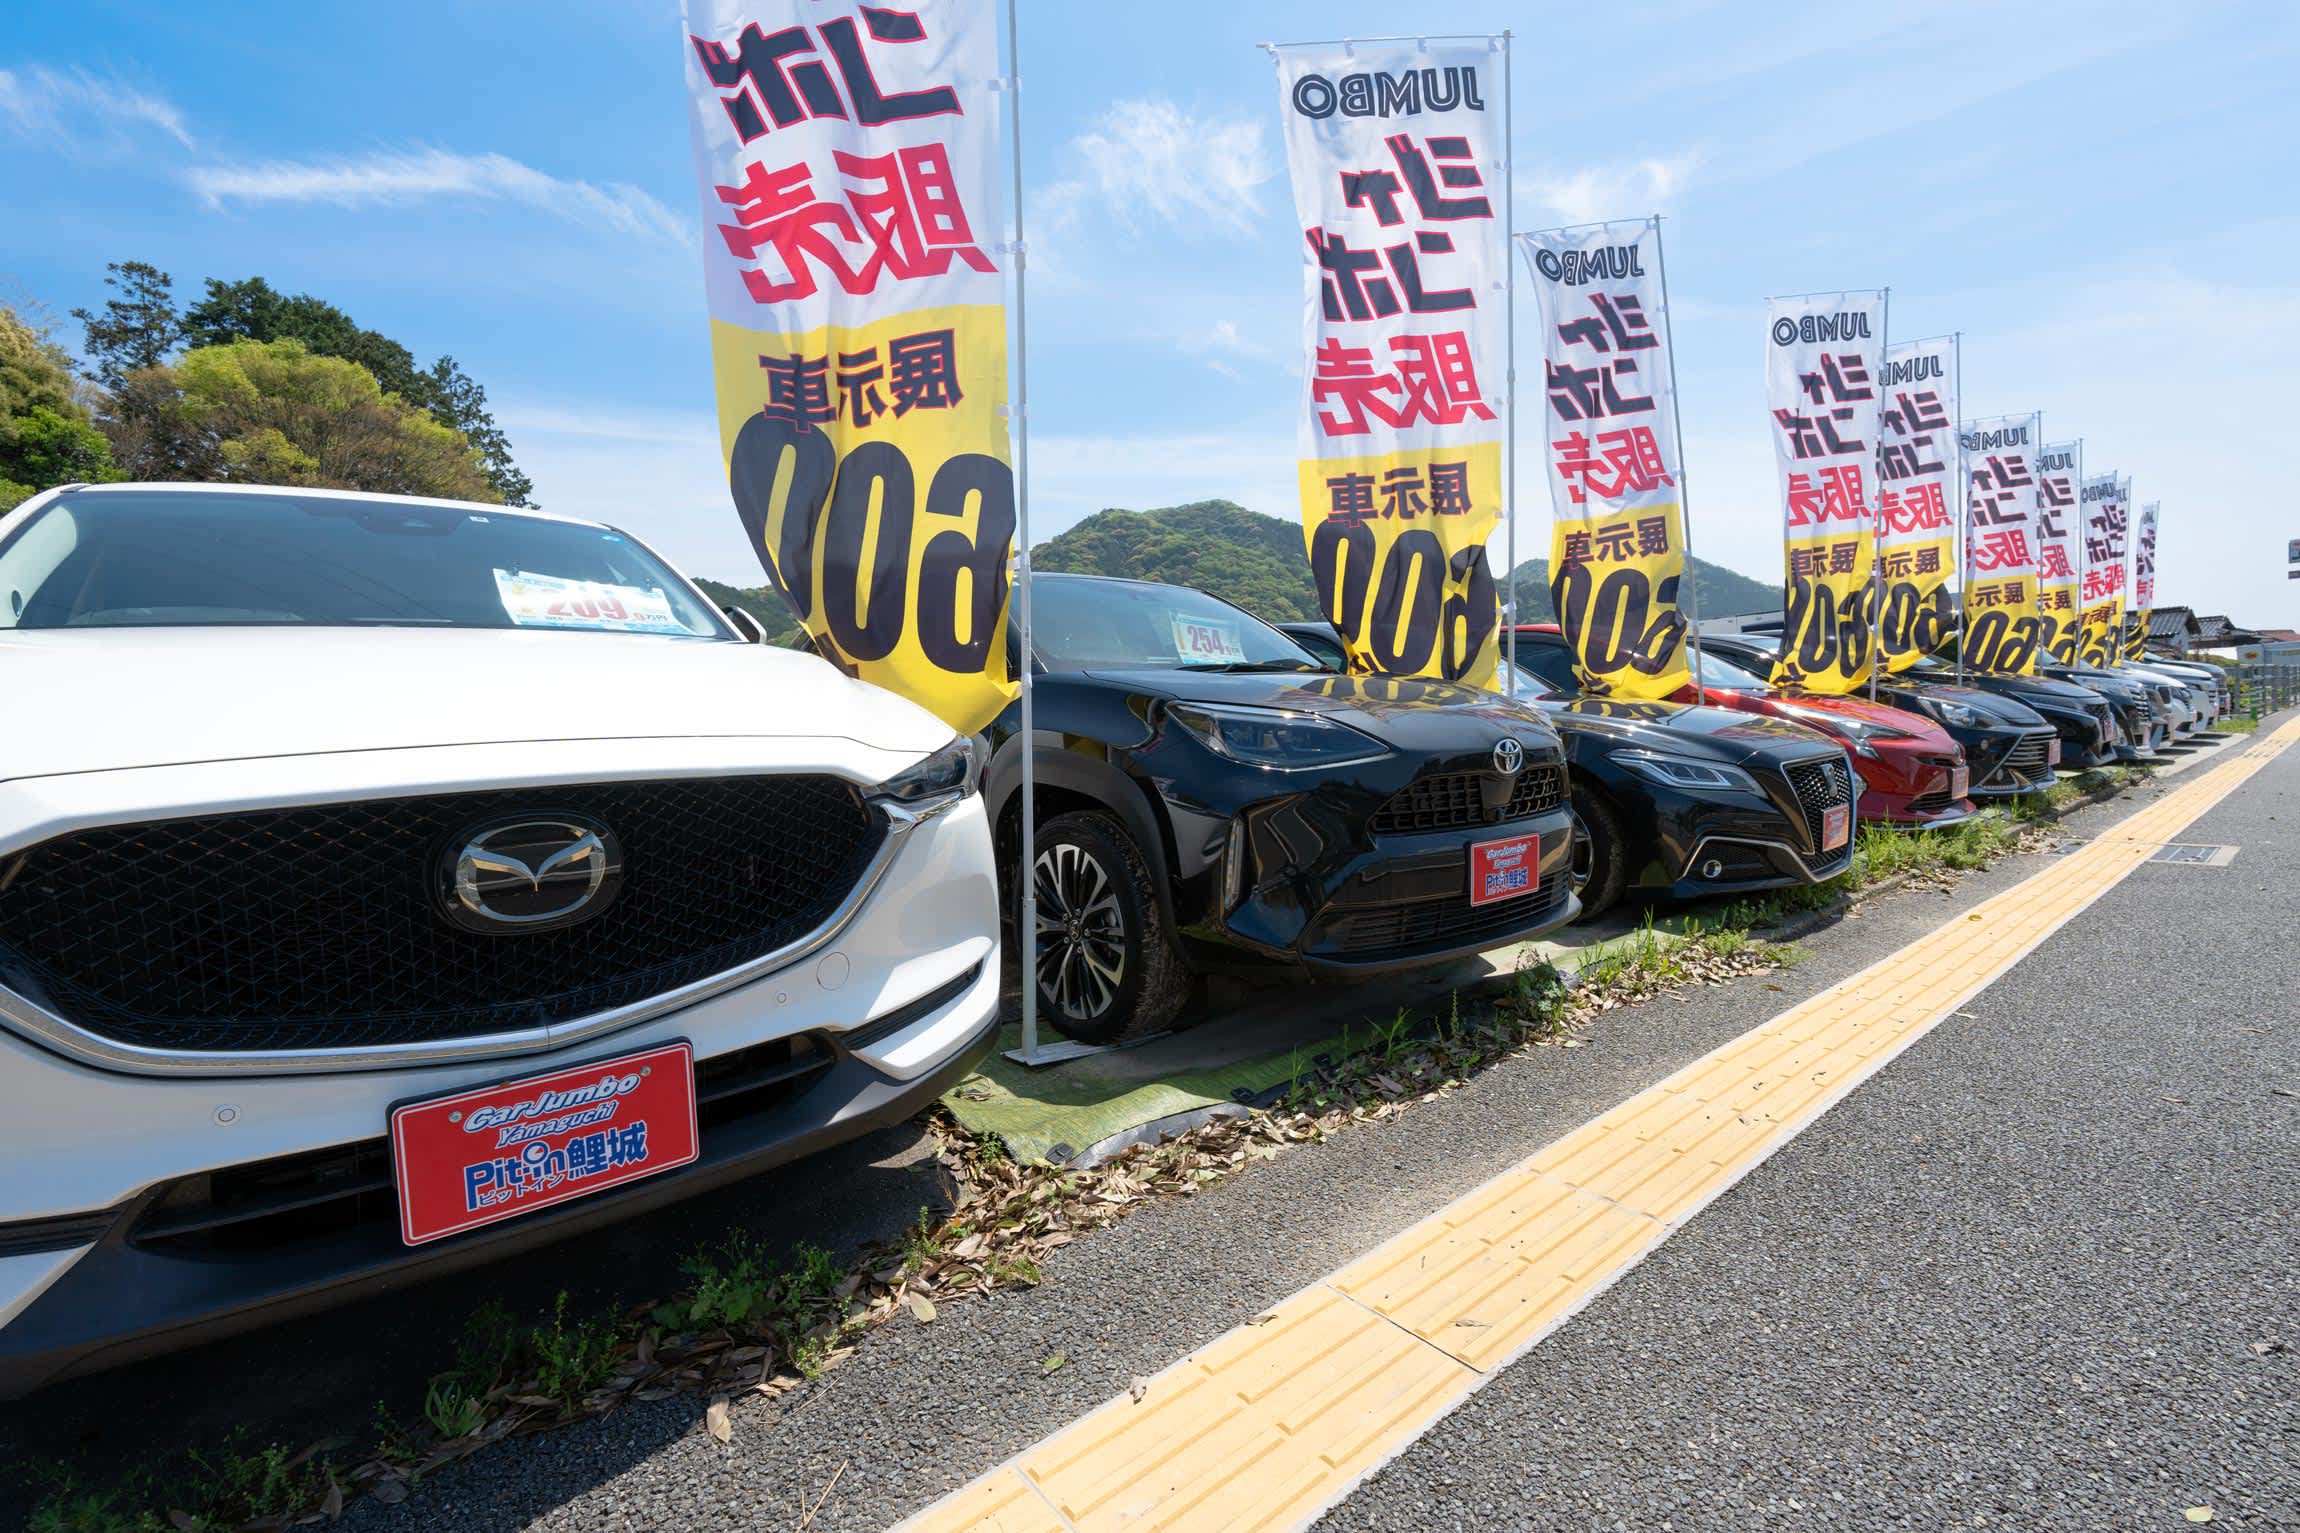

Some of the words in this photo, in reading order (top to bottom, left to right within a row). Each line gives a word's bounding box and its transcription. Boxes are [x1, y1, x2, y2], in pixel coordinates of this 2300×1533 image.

[496, 1101, 621, 1149] Yamaguchi
[479, 1172, 566, 1208] ピットイン
